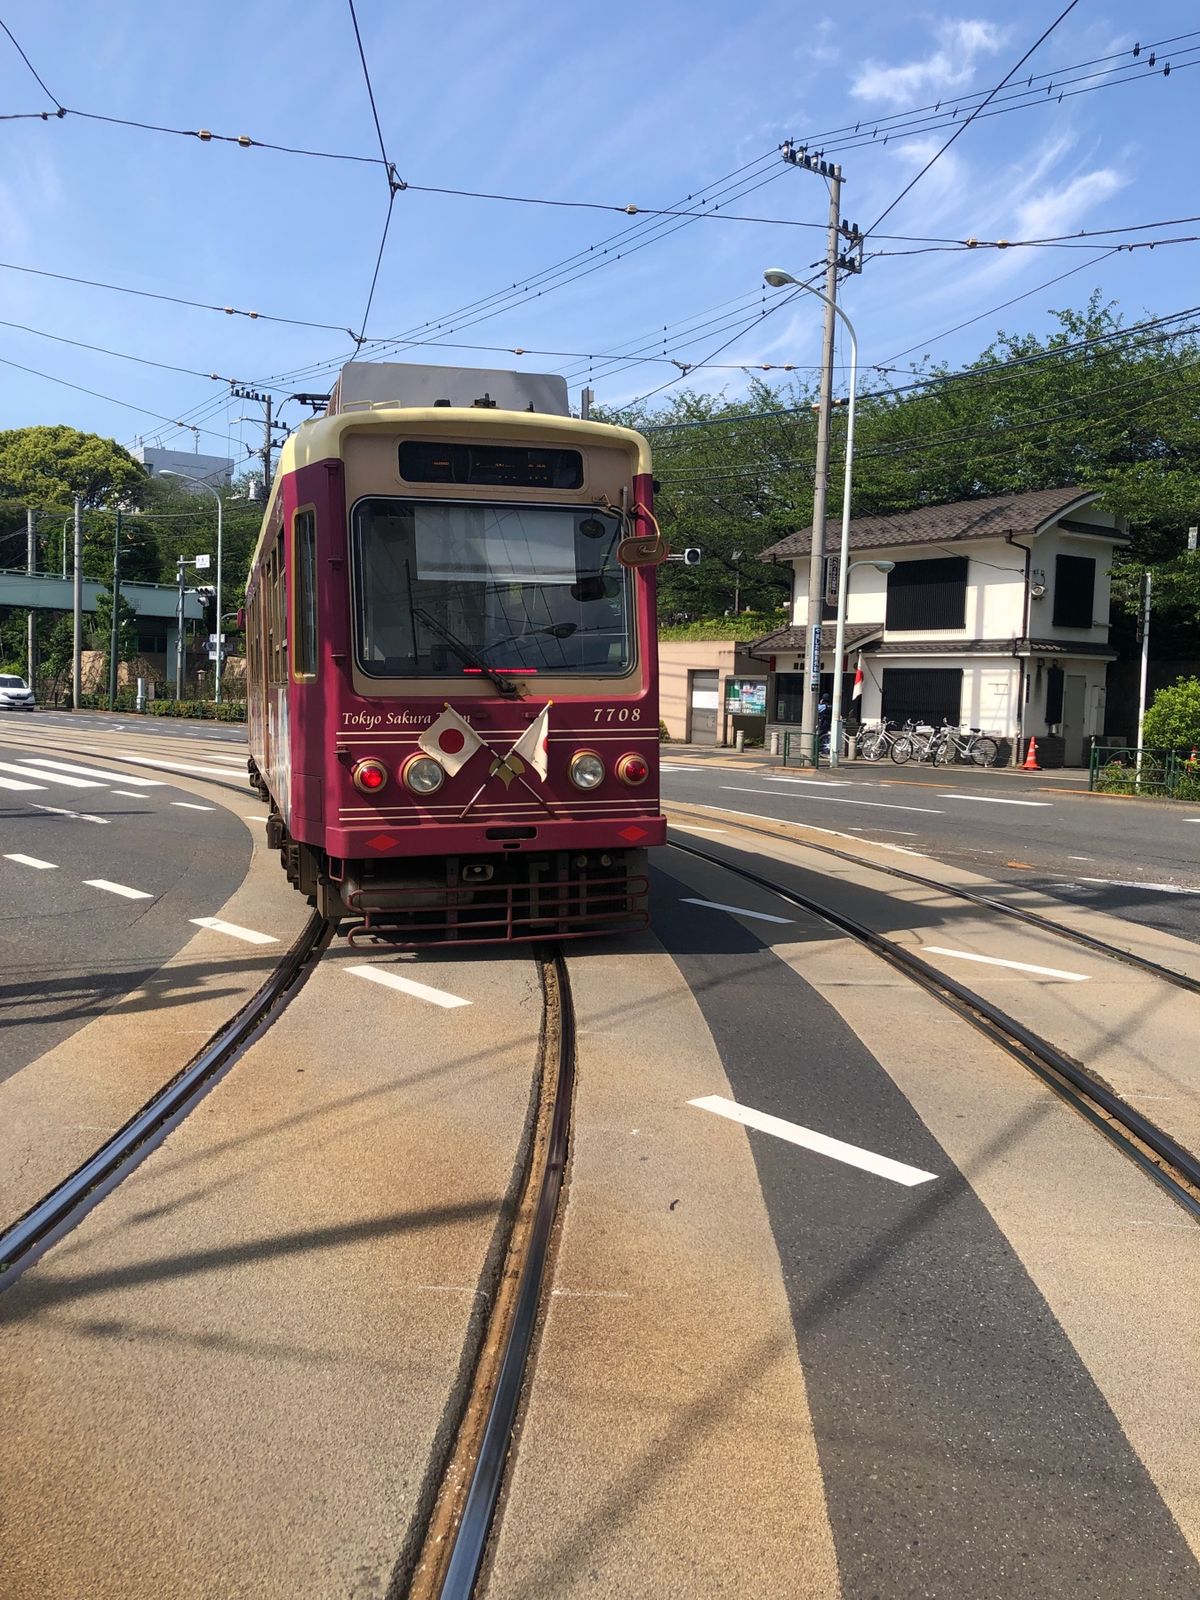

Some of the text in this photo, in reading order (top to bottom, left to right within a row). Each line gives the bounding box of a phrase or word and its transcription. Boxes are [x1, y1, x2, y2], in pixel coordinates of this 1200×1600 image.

[342, 710, 382, 730] Tokyo
[385, 710, 431, 725] Sakura
[593, 708, 641, 722] 7708
